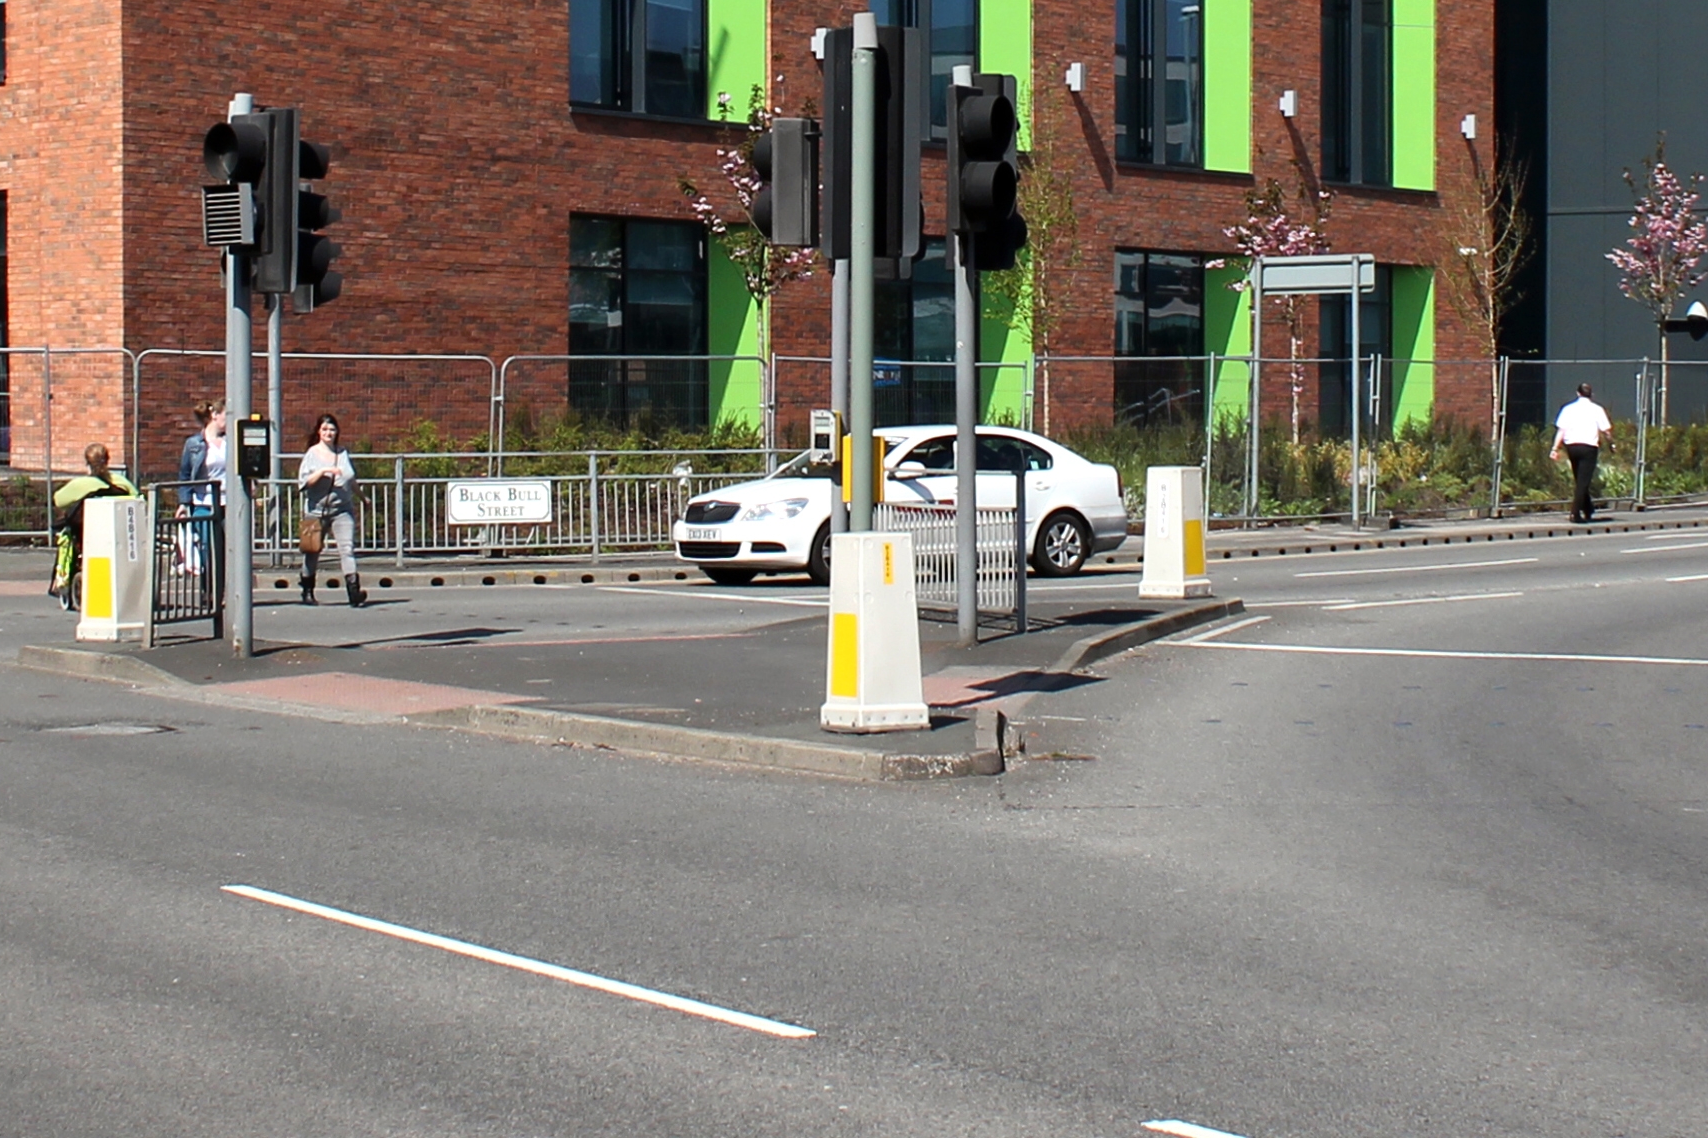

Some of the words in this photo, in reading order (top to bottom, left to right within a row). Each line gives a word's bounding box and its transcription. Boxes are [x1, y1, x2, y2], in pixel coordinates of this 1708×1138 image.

[459, 488, 502, 502] BLACK
[507, 487, 541, 502] BULL
[477, 503, 525, 517] STREET
